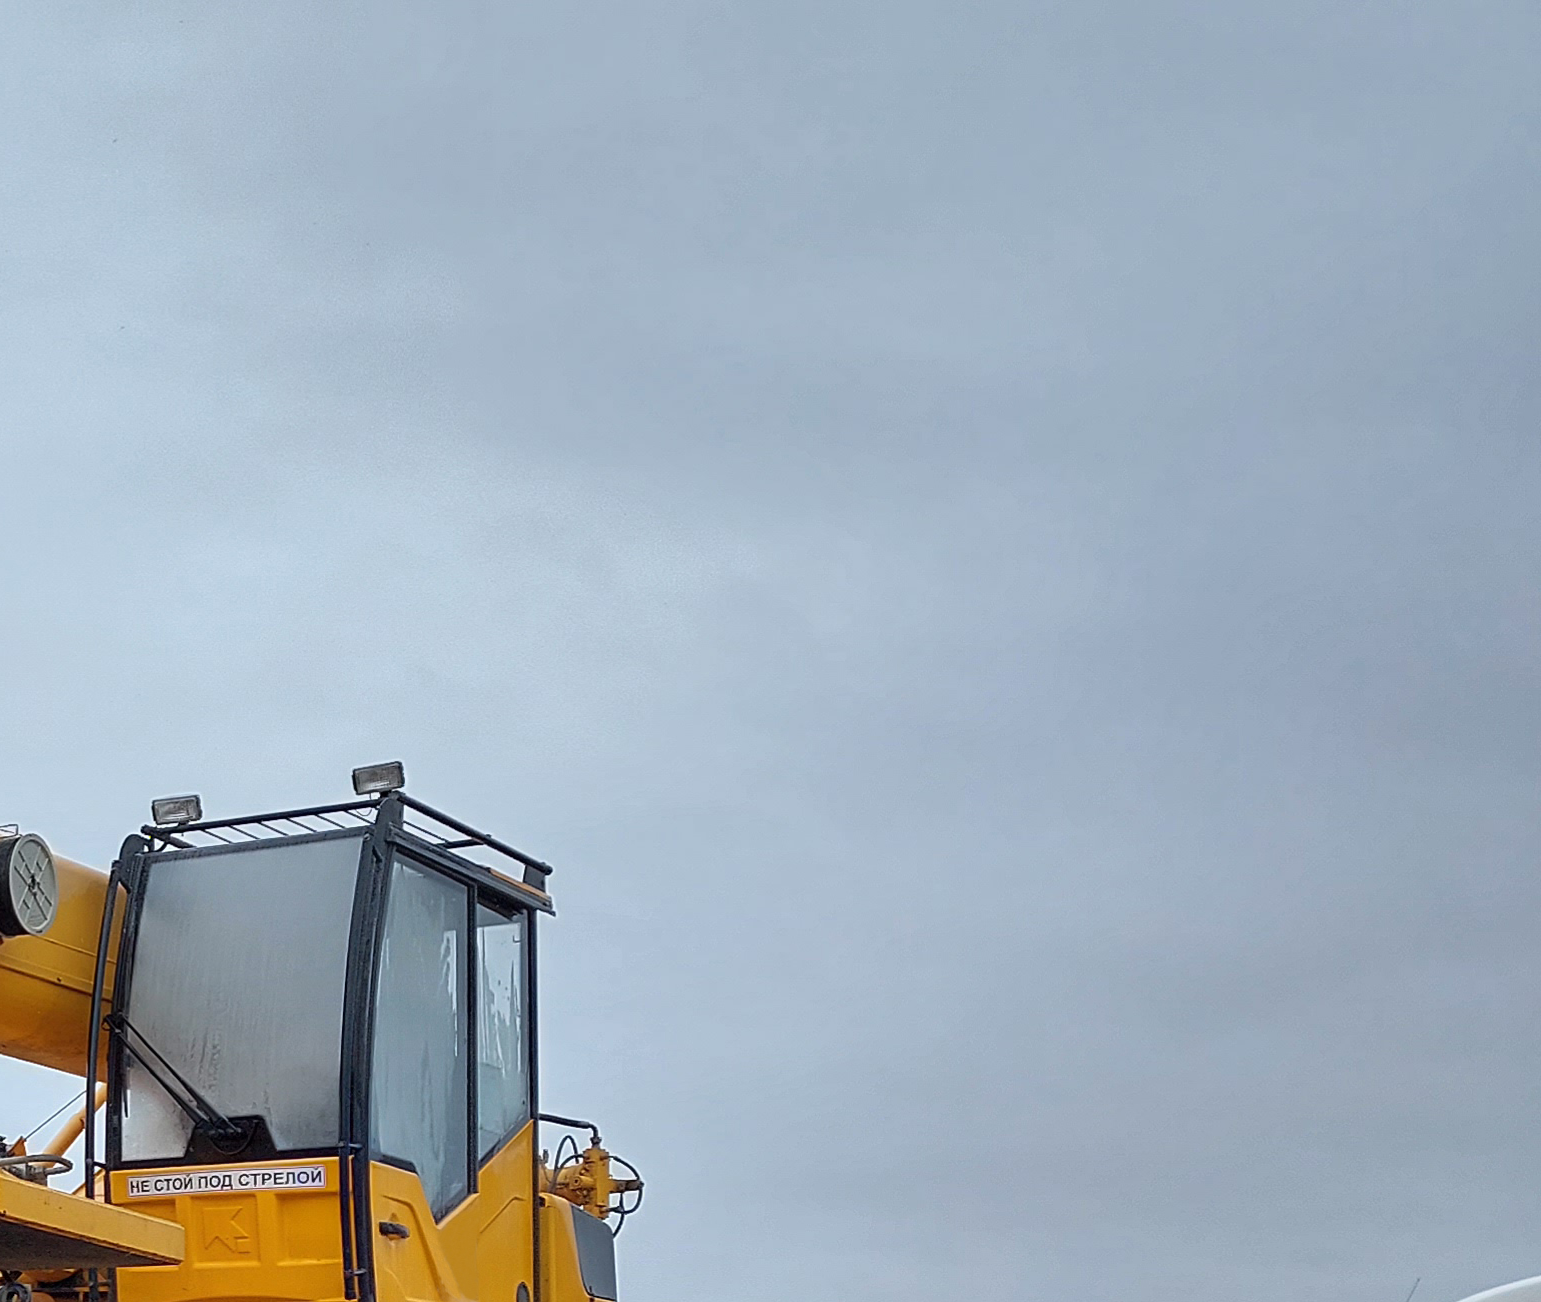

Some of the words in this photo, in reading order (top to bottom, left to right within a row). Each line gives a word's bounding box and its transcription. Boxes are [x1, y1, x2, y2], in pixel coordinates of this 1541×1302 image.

[129, 1179, 150, 1193] НЕ
[154, 1174, 193, 1192] СТОЙ
[198, 1175, 233, 1190] ПОД
[238, 1167, 322, 1187] СТРЕЛОЙ
